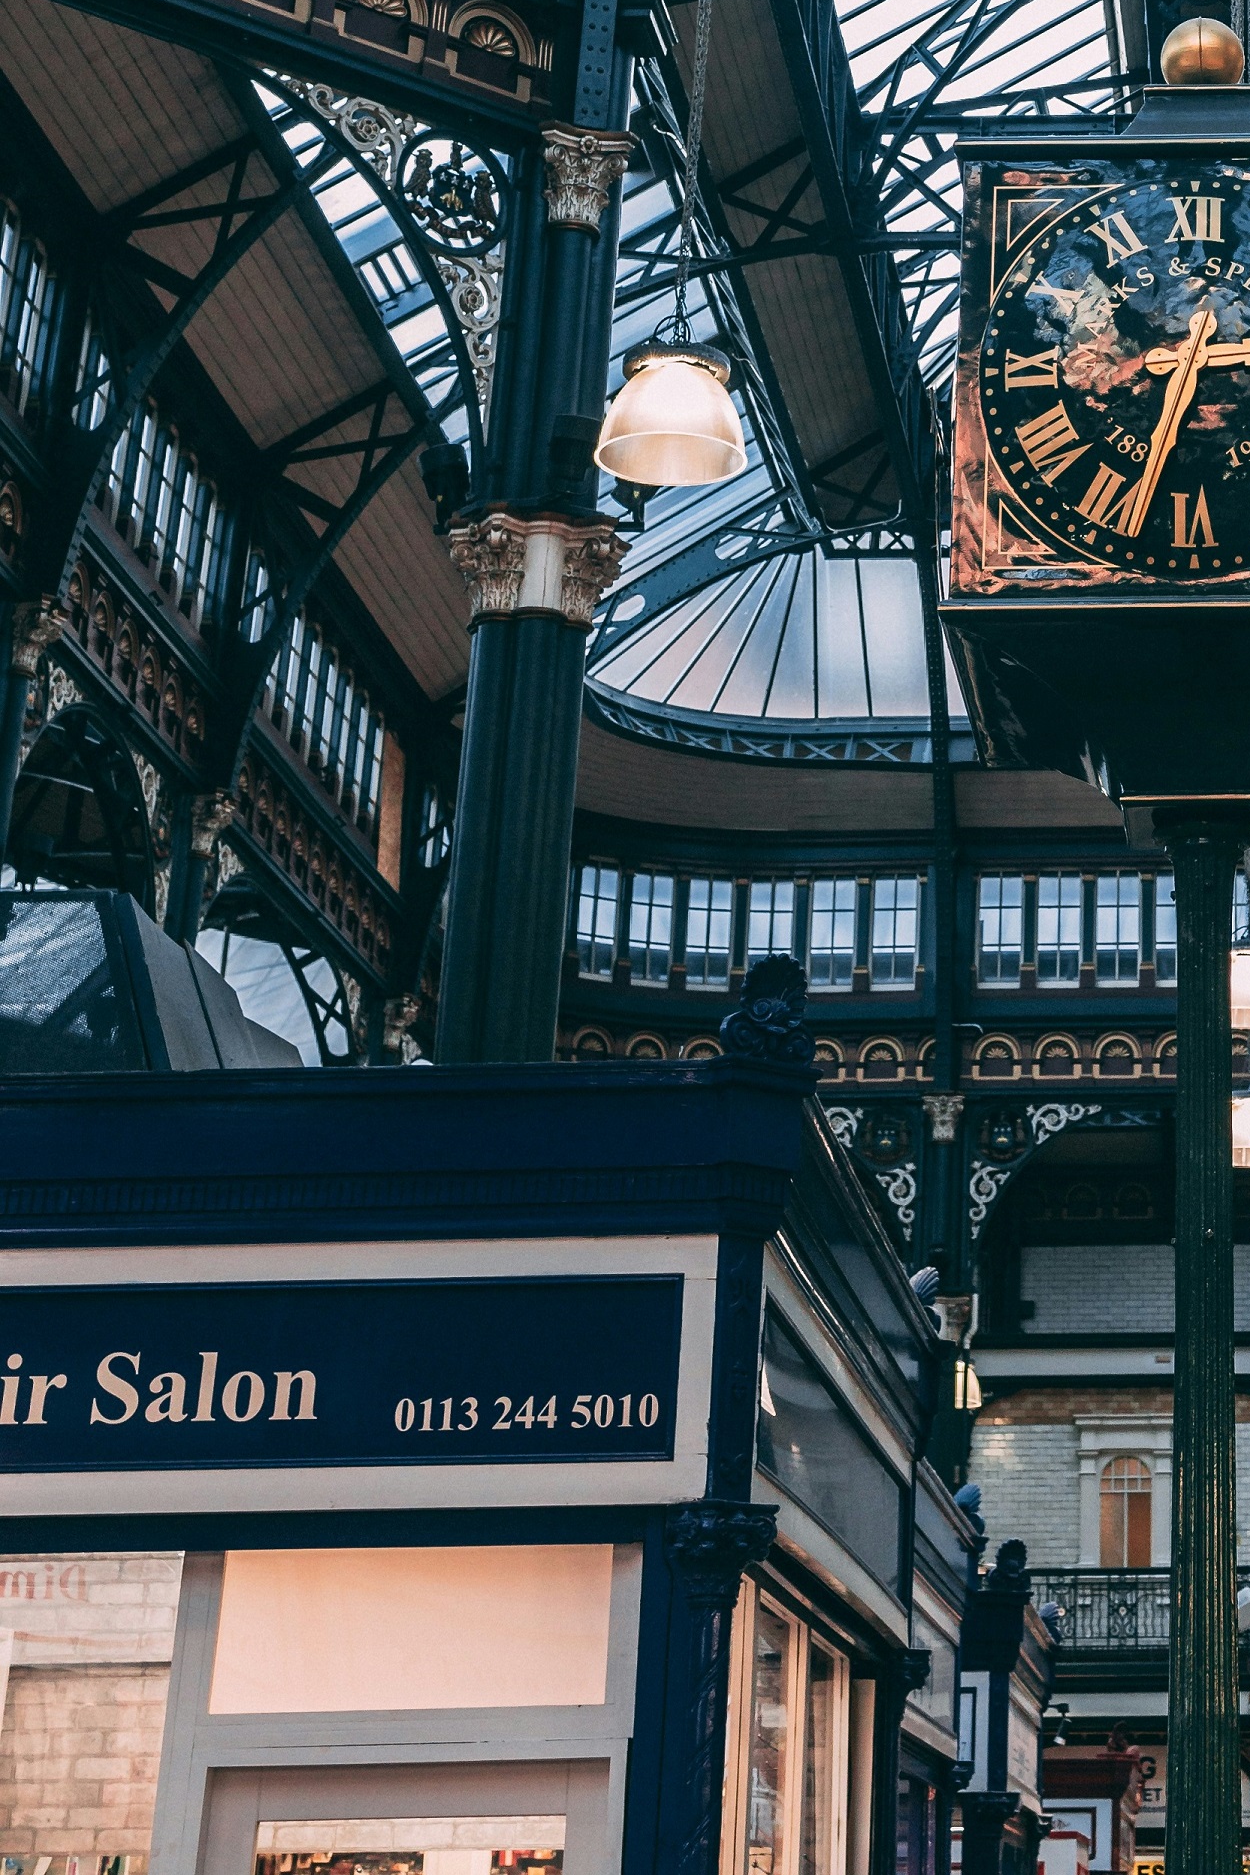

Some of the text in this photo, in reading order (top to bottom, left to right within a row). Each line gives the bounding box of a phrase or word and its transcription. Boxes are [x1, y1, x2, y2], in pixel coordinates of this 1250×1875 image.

[1084, 210, 1148, 269] XI
[1165, 196, 1225, 243] XII
[1025, 270, 1085, 316] X
[1078, 266, 1155, 368] MARKS
[1168, 256, 1191, 277] &
[1005, 345, 1061, 392] IX
[1015, 400, 1095, 488] VIII
[1104, 423, 1150, 463] 188
[1170, 484, 1219, 548] VI
[0, 1351, 319, 1426] ir Salon
[394, 1393, 660, 1433] 0113 244 5010
